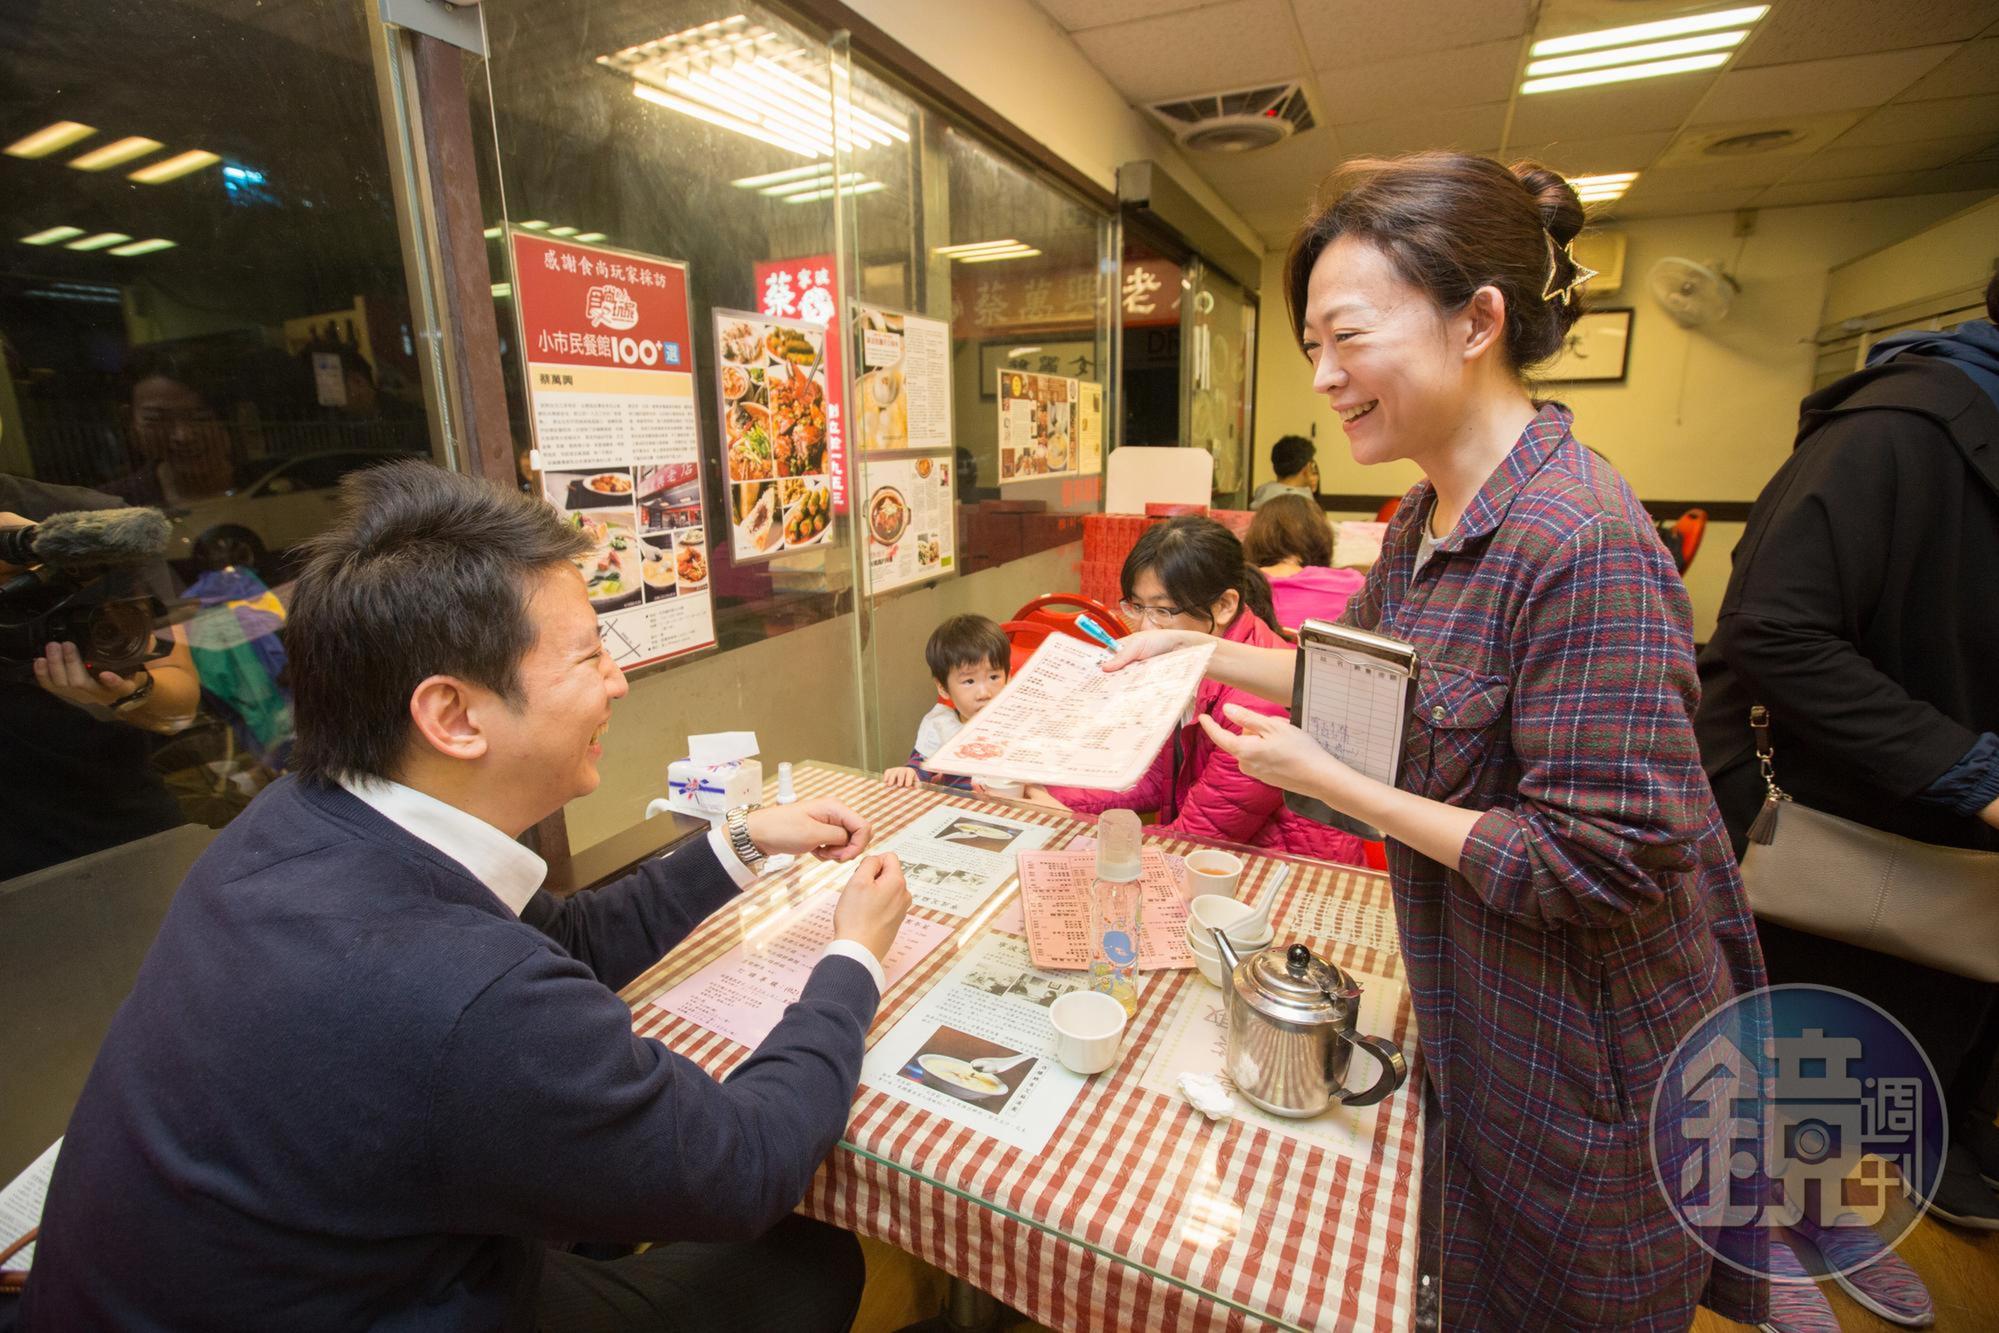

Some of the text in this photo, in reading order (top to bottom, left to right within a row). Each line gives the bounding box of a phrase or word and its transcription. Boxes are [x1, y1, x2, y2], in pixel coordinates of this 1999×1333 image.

[544, 249, 667, 289] 感謝食尚玩家採訪
